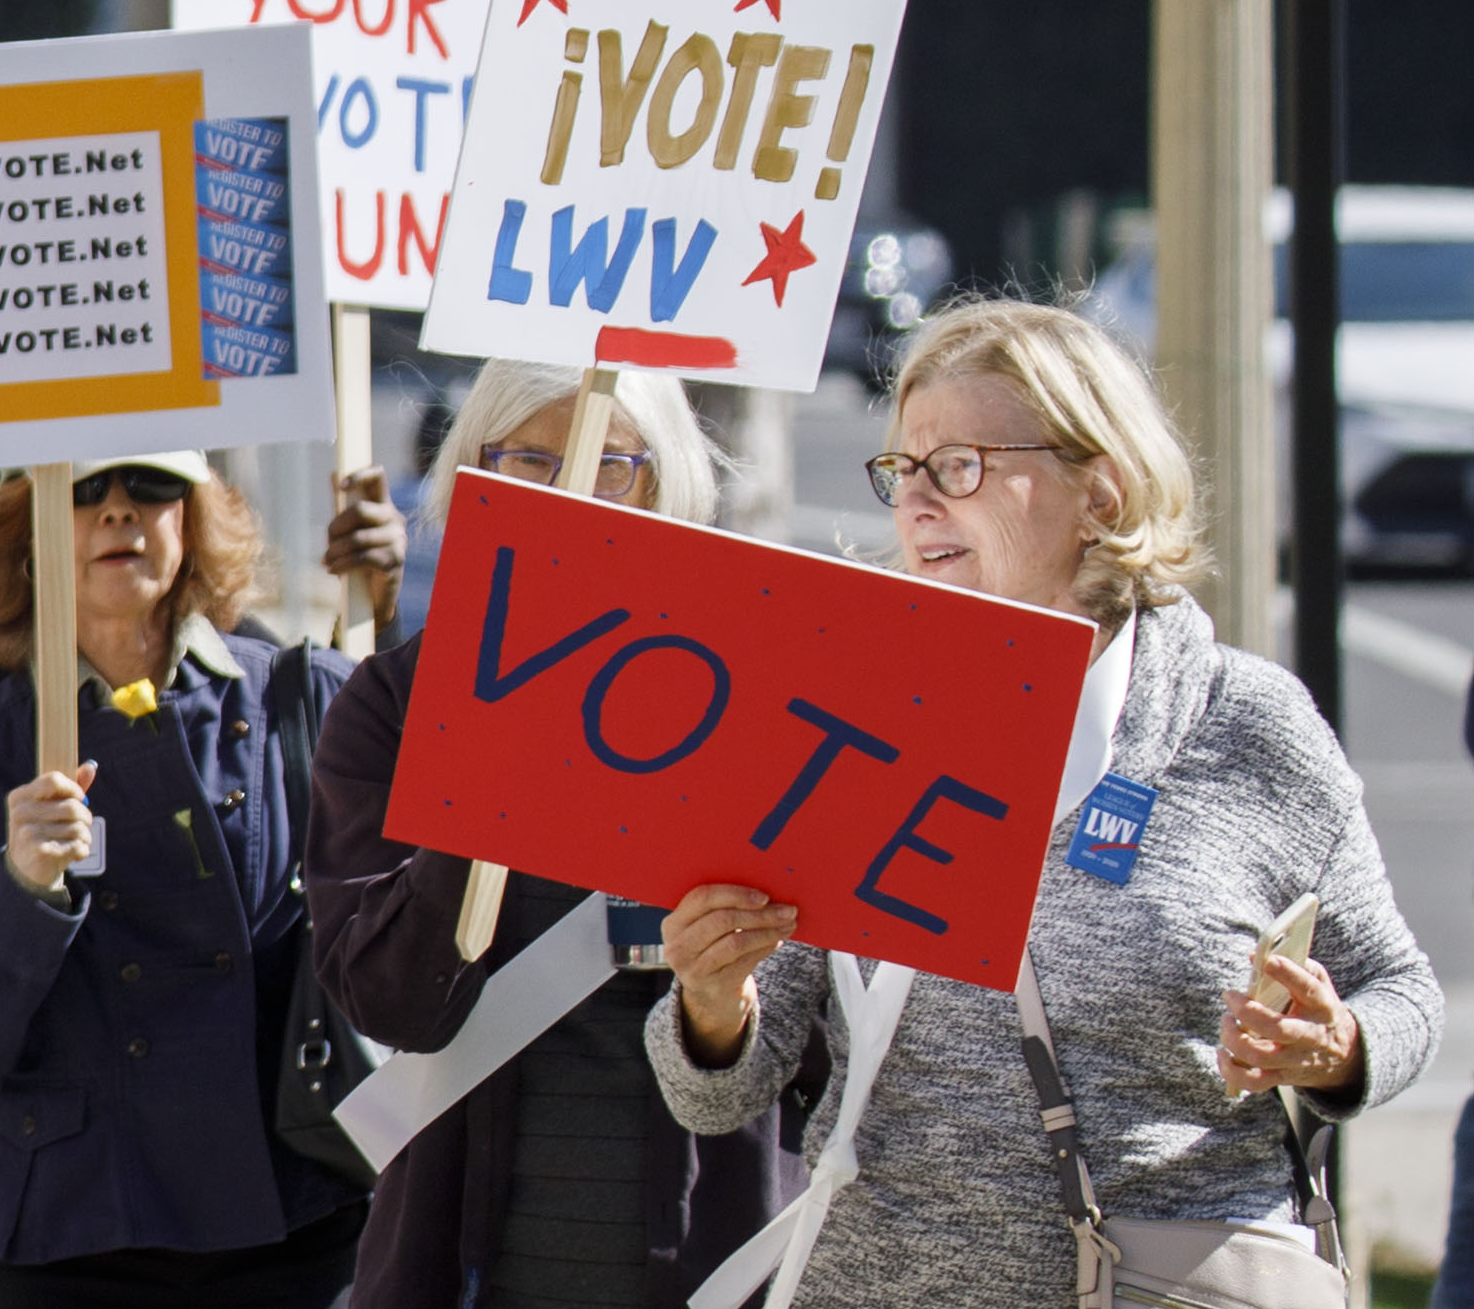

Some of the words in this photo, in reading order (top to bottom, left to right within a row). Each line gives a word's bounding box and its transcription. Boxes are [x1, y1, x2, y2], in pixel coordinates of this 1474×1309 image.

[317, 72, 477, 173] OT
[539, 19, 877, 202] ¡VOTE!
[206, 130, 274, 170] VOTE
[207, 182, 275, 222] VOTE
[210, 235, 277, 274] VOTE
[487, 199, 719, 323] LWV
[212, 287, 279, 326] VOTE
[213, 338, 281, 377] VOTE
[473, 547, 1010, 937] VOTE
[1083, 806, 1139, 845] LWV
